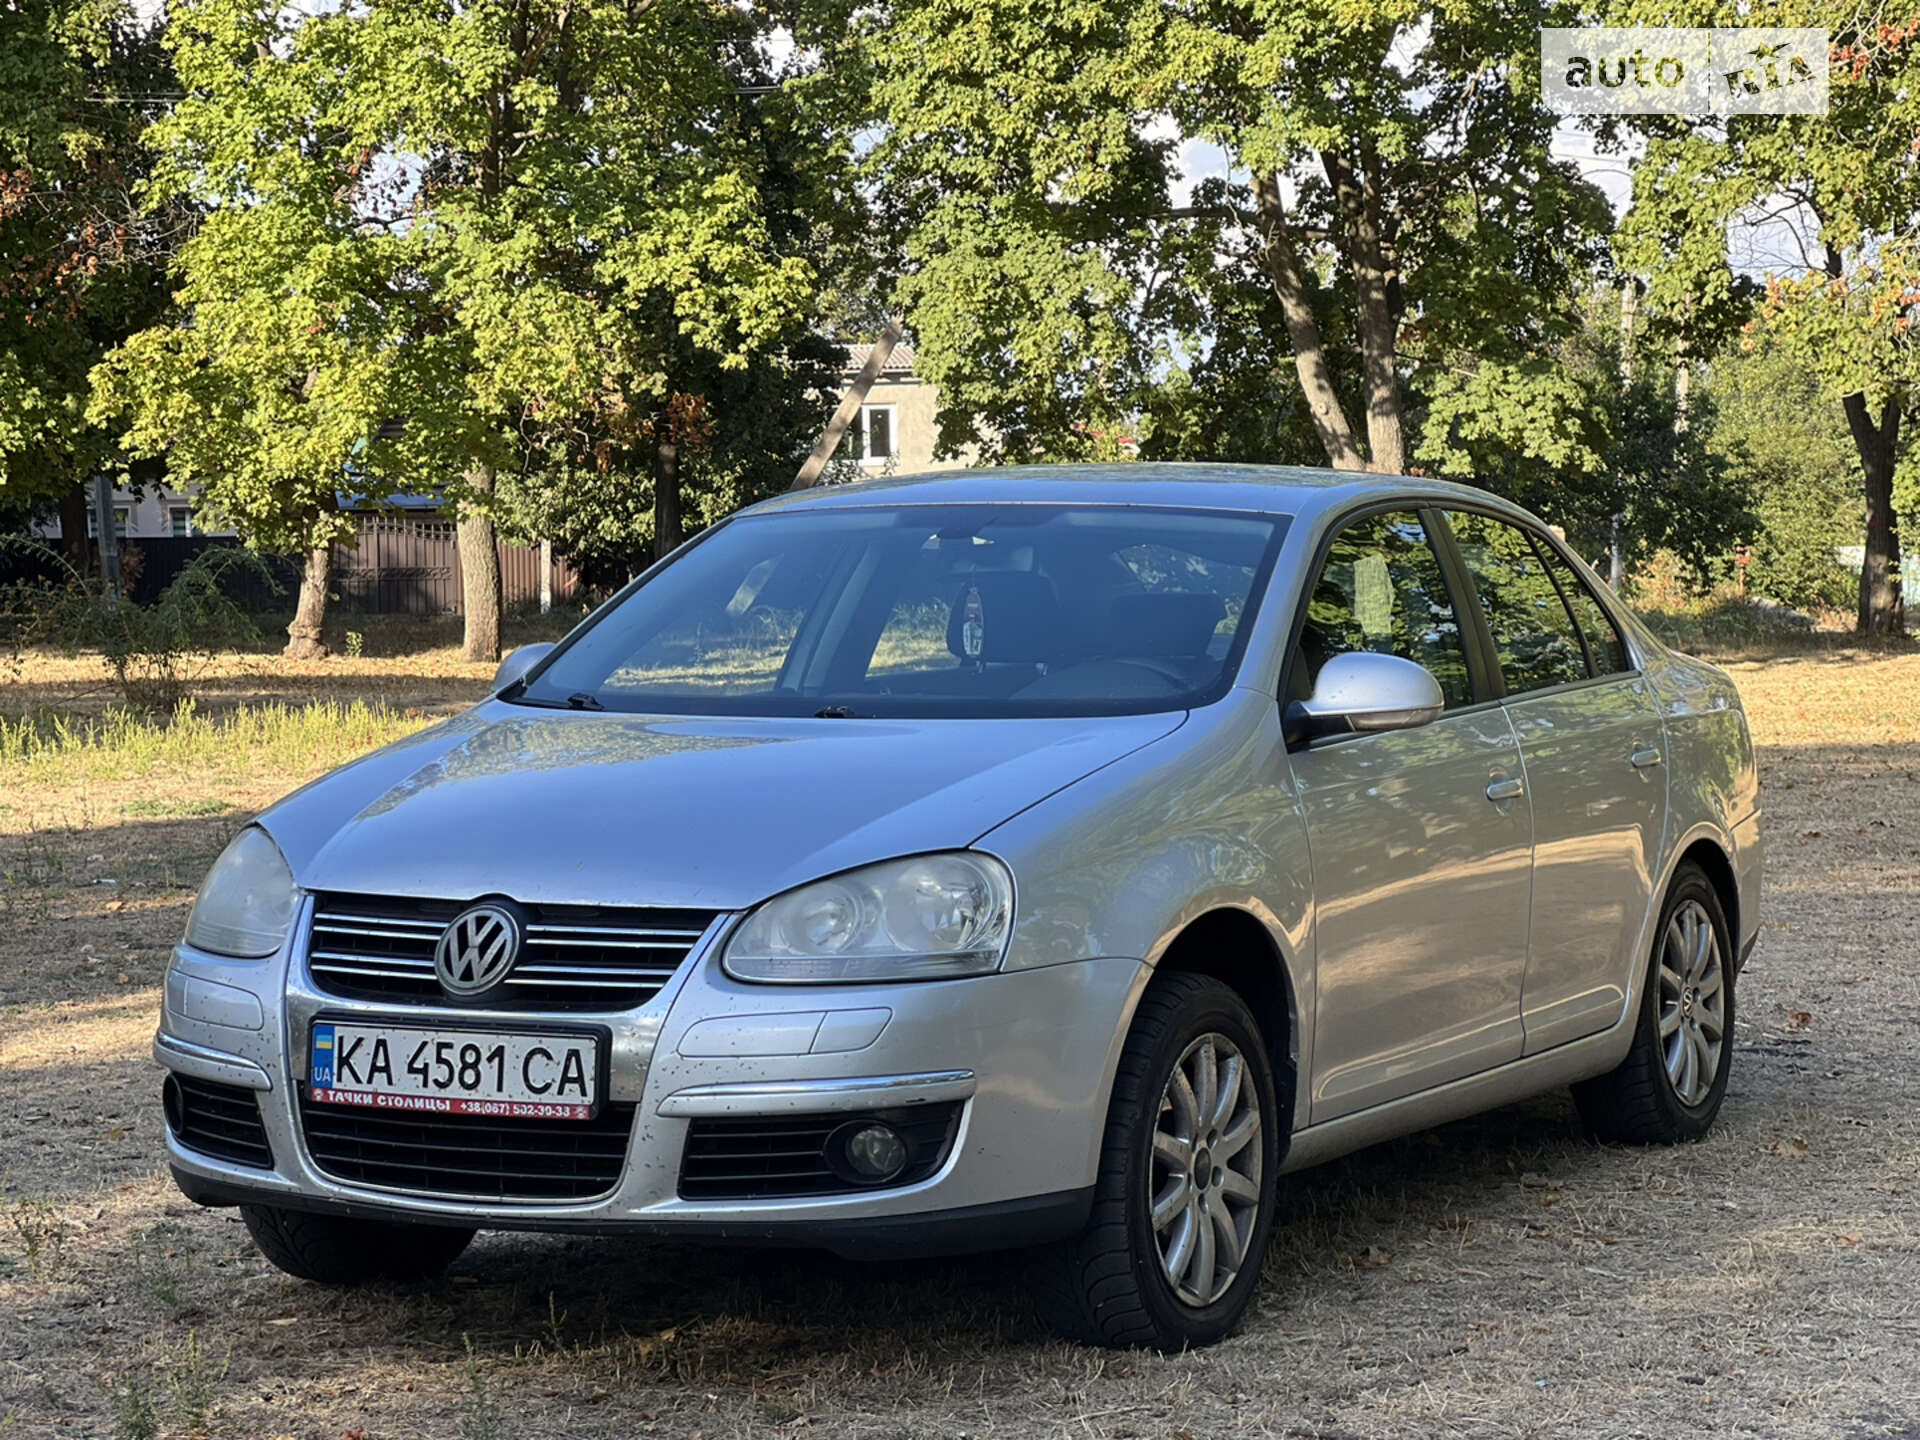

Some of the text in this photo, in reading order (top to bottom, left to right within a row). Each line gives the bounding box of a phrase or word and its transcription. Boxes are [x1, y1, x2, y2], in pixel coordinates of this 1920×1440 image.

[314, 1065, 332, 1083] UA
[336, 1036, 588, 1097] KA 4581 CA
